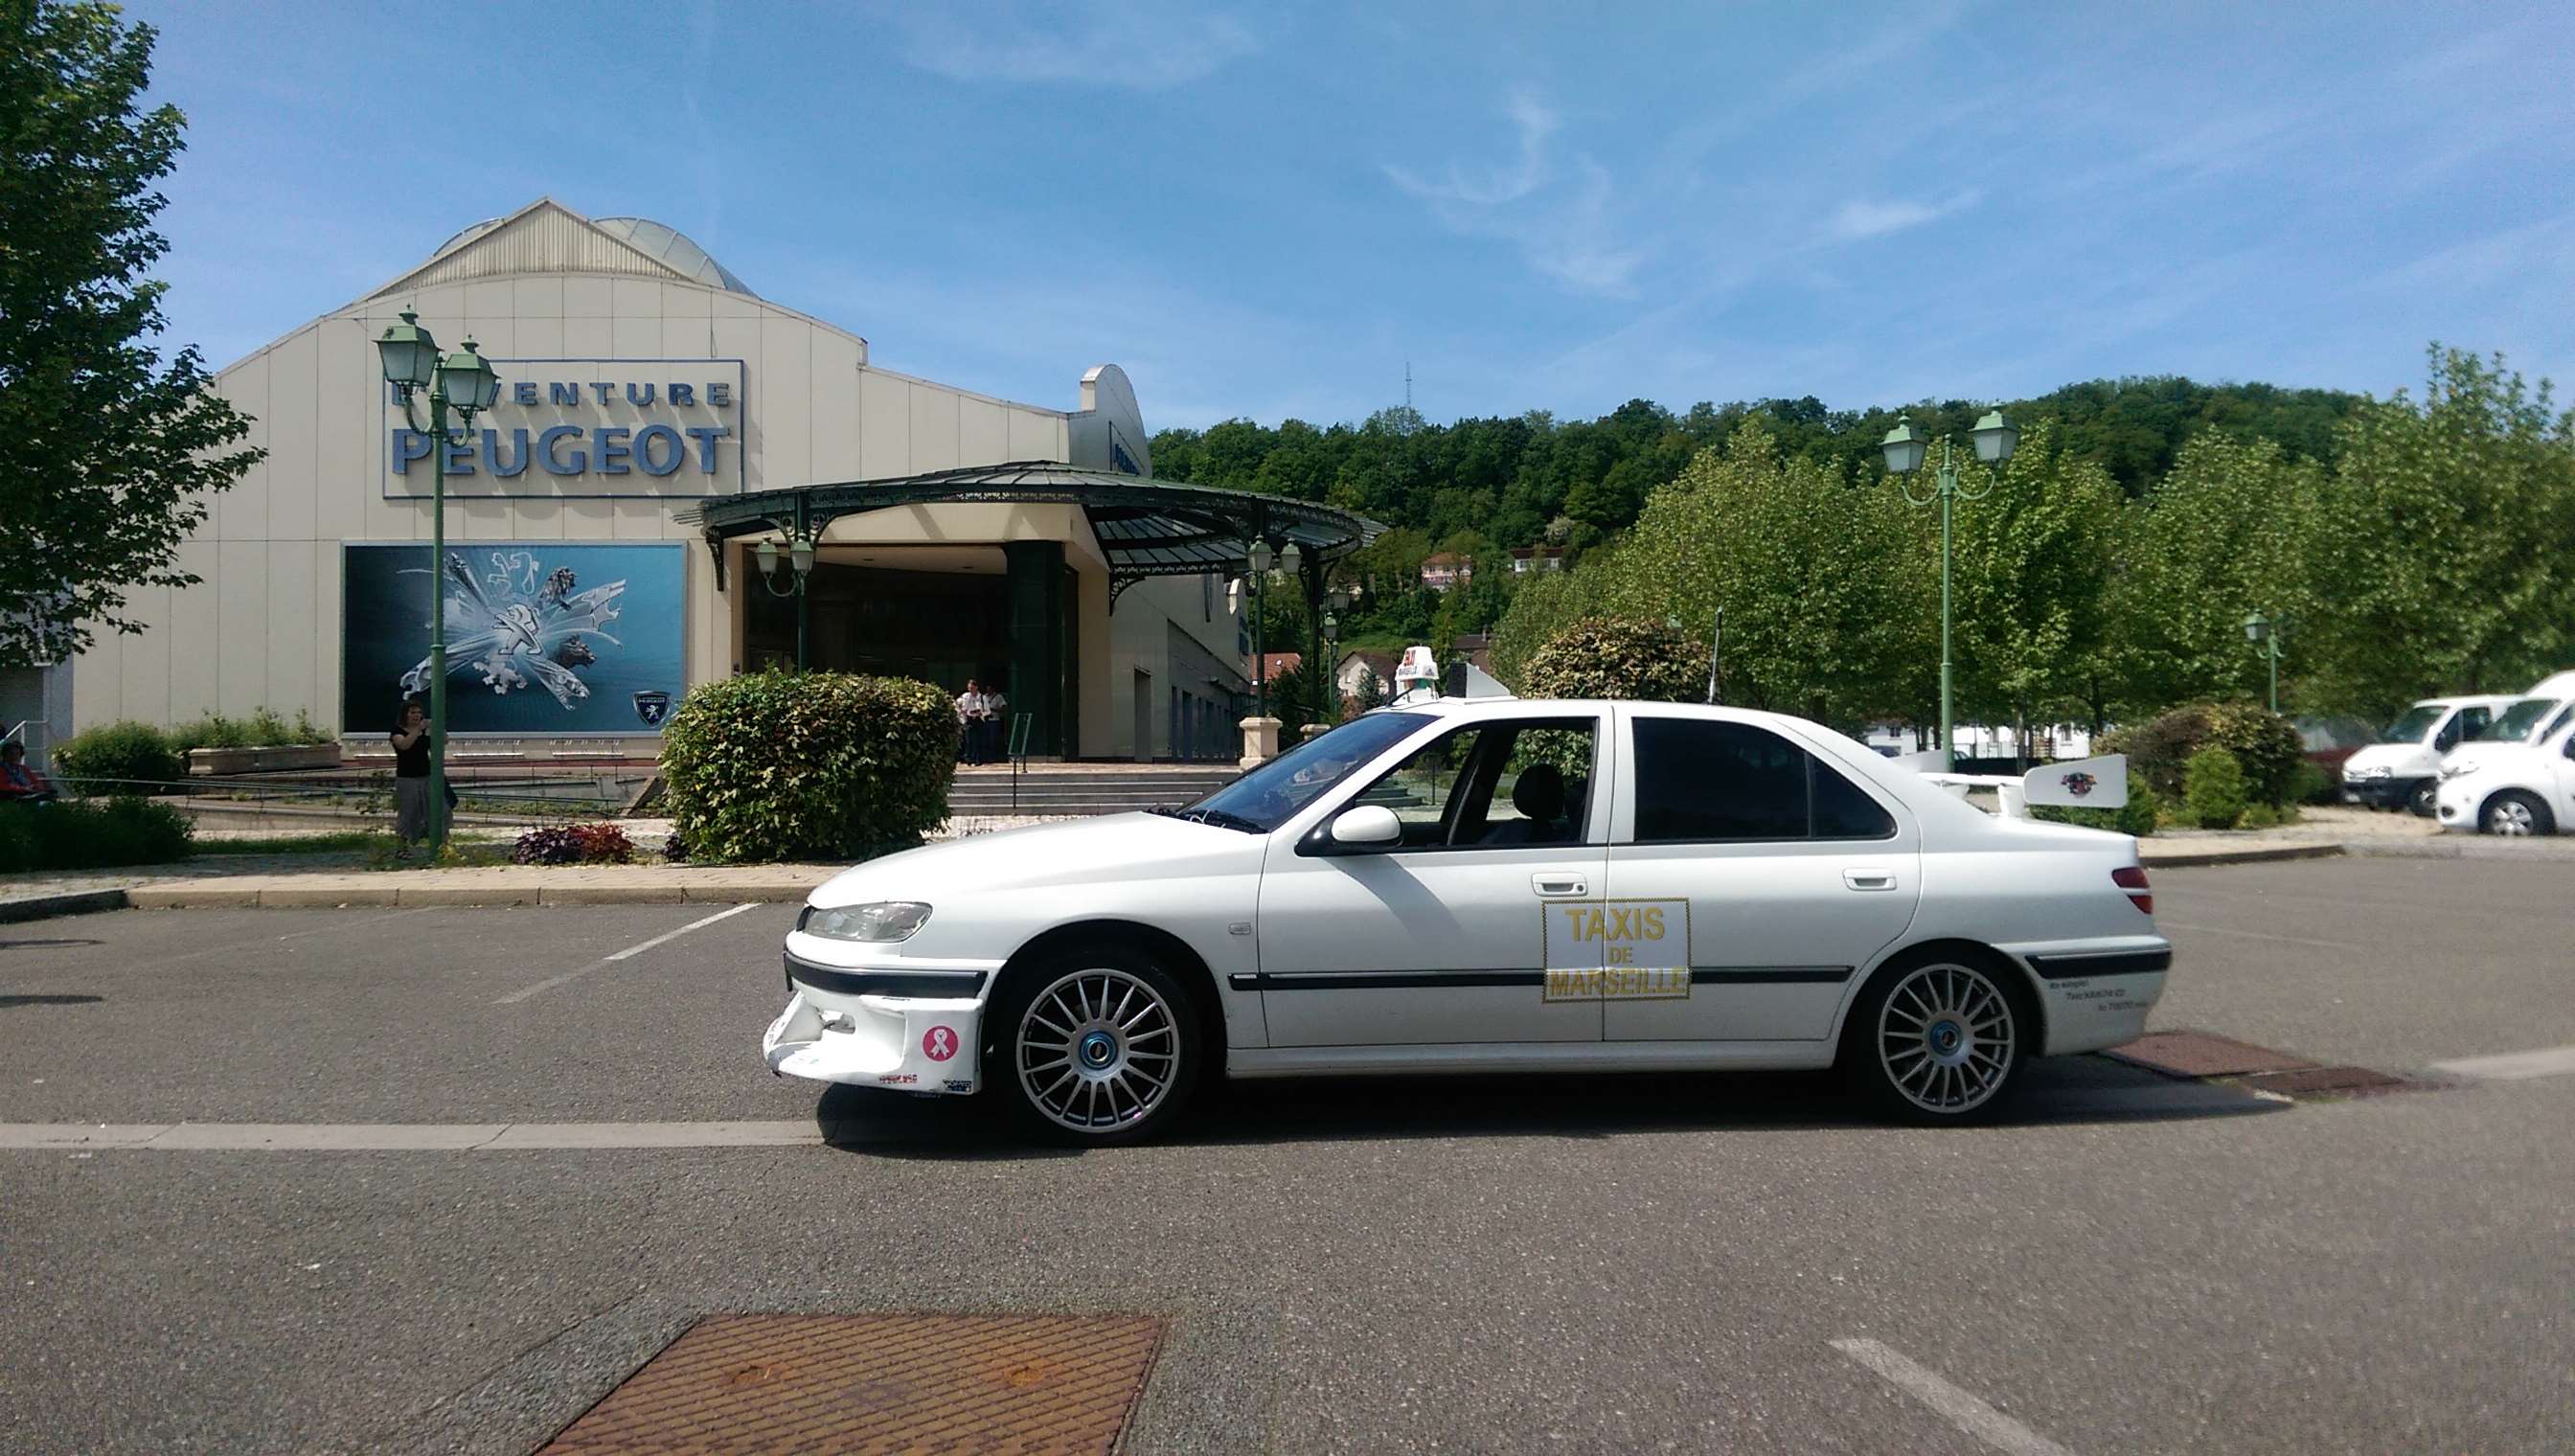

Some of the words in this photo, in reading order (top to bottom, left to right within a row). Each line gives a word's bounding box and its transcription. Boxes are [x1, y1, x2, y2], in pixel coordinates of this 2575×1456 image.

[392, 424, 731, 476] PEUGEOT
[1564, 907, 1665, 942] TAXIS
[1609, 946, 1633, 964] DE
[1550, 967, 1686, 996] MARSEILLE
